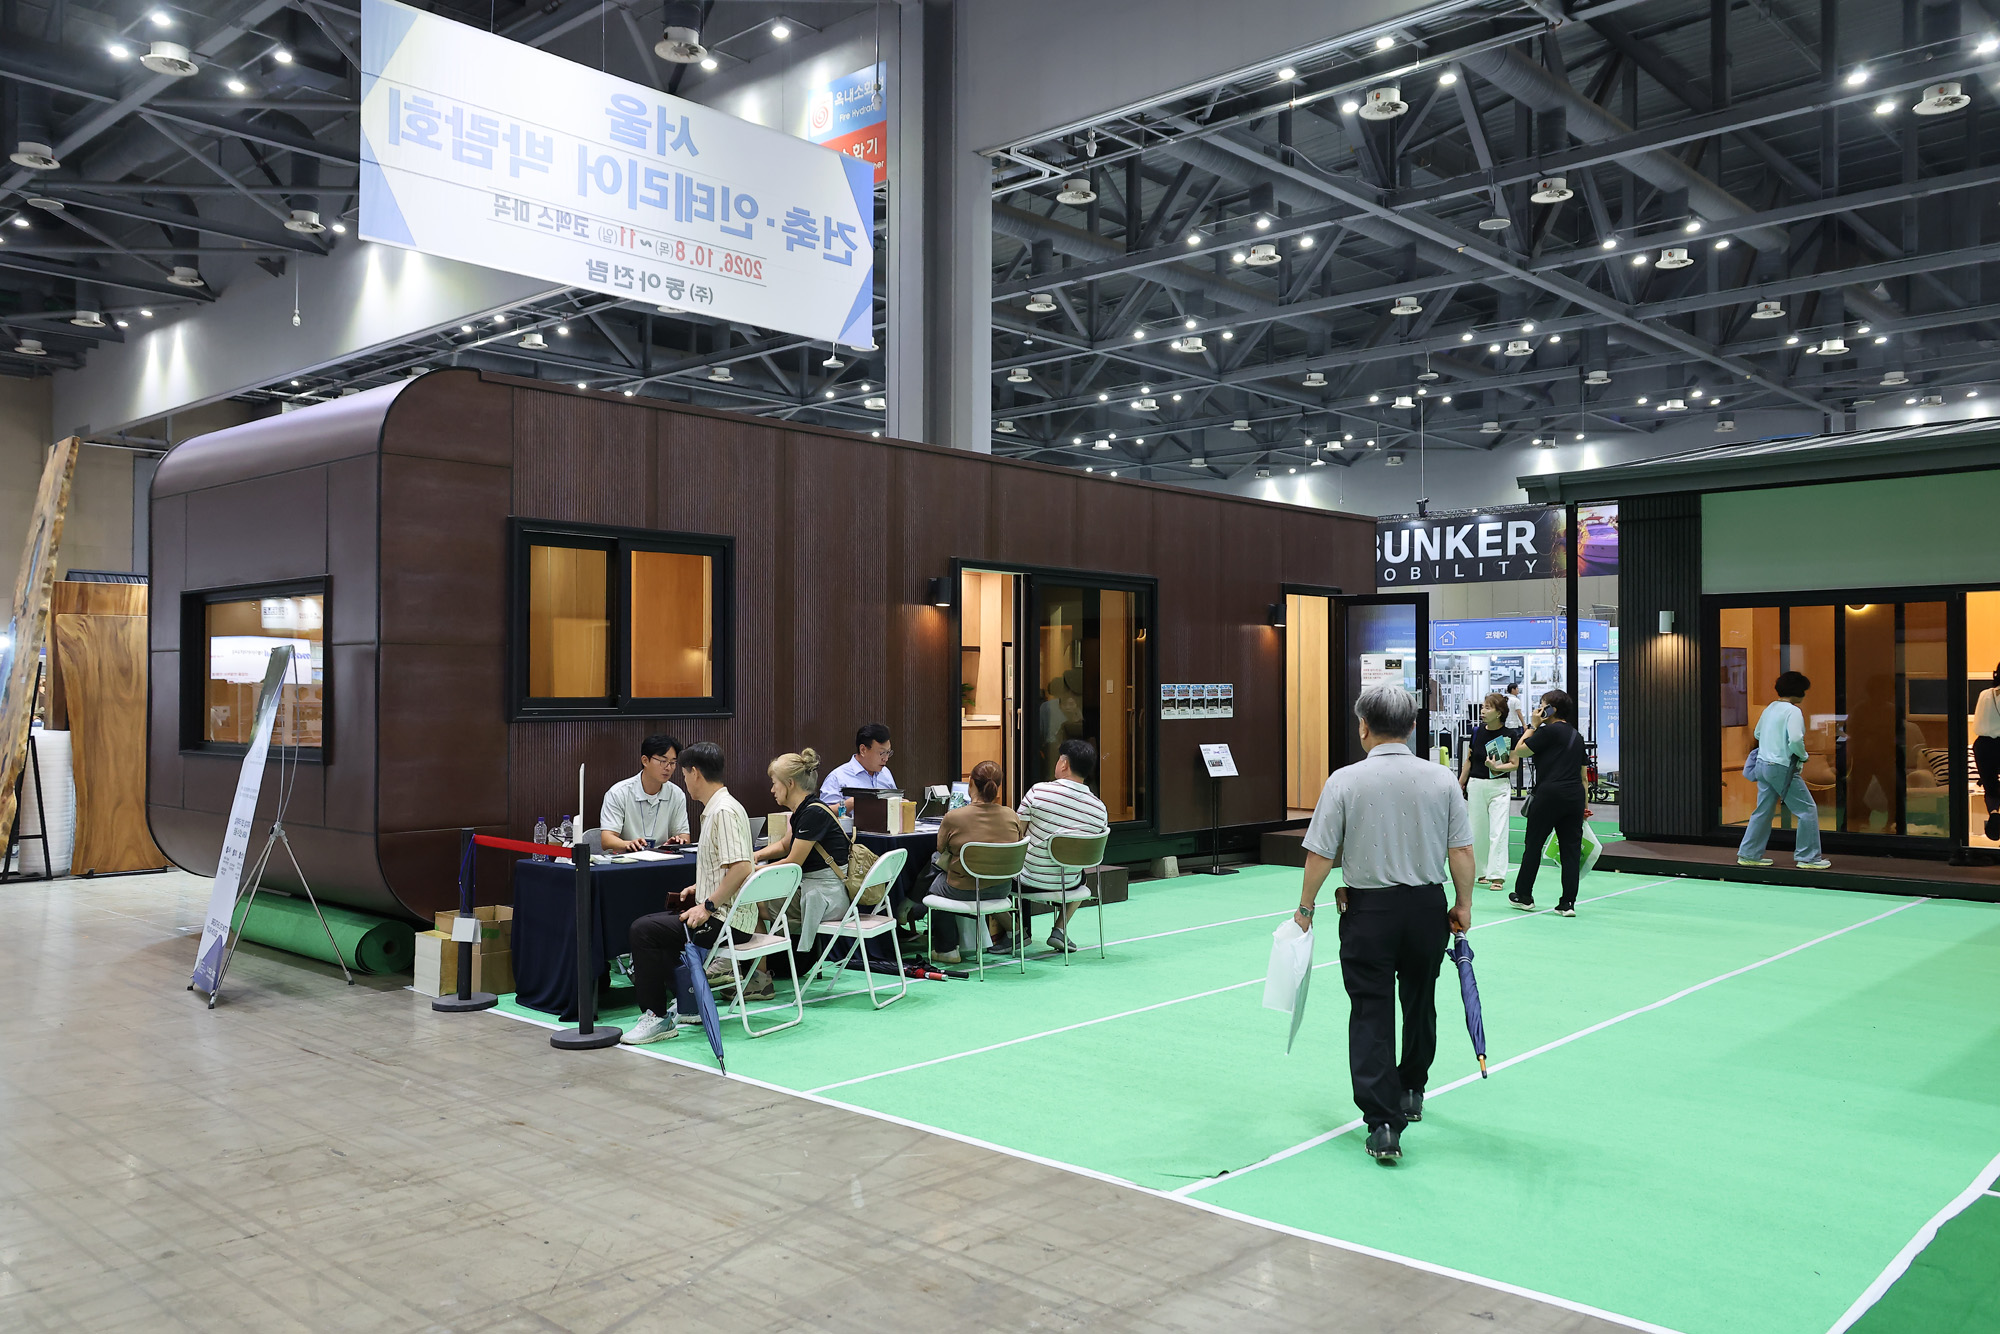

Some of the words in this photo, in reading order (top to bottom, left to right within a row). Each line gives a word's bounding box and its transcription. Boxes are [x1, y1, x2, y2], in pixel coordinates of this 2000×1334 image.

[852, 104, 876, 118] Hydran
[842, 137, 878, 160] 화기
[1383, 559, 1538, 582] OBILITY
[1484, 630, 1508, 640] 코웨이
